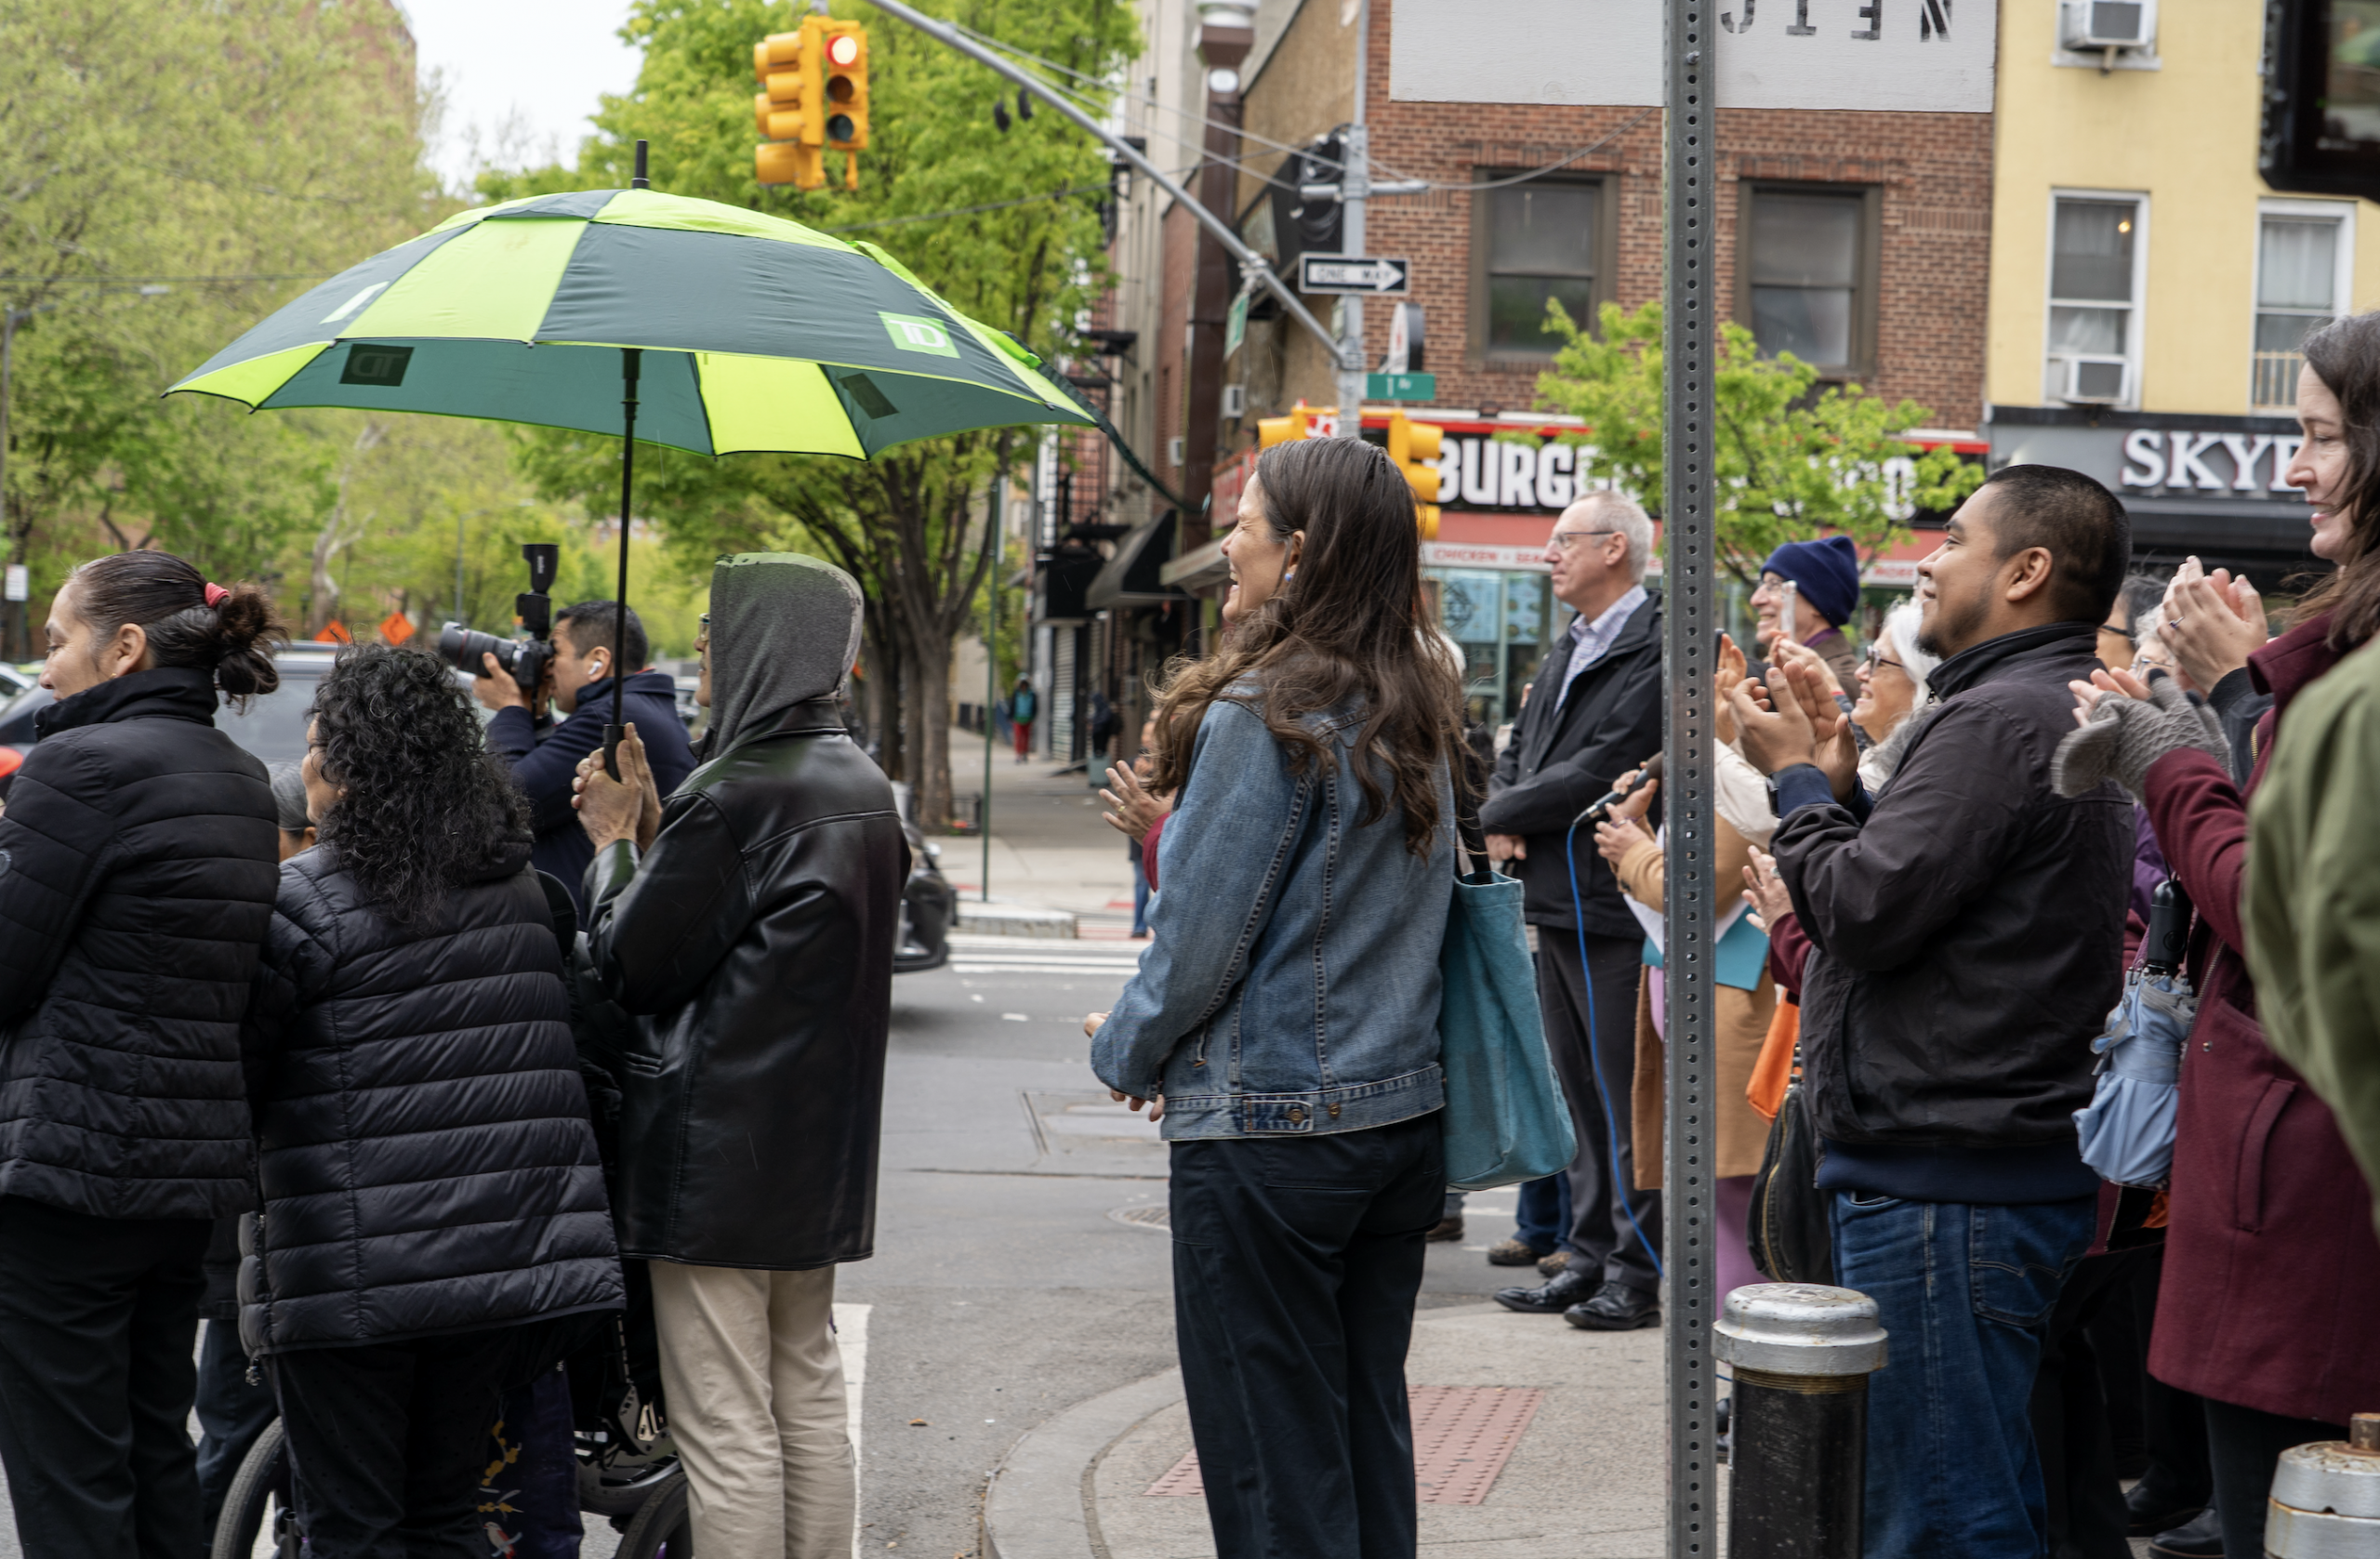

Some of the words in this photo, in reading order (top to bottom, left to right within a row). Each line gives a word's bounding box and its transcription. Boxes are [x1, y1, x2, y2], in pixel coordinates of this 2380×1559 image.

[1317, 268, 1346, 278] ONE
[1362, 270, 1391, 280] WAY
[888, 319, 947, 349] TD
[1435, 548, 1499, 562] CHICKEN
